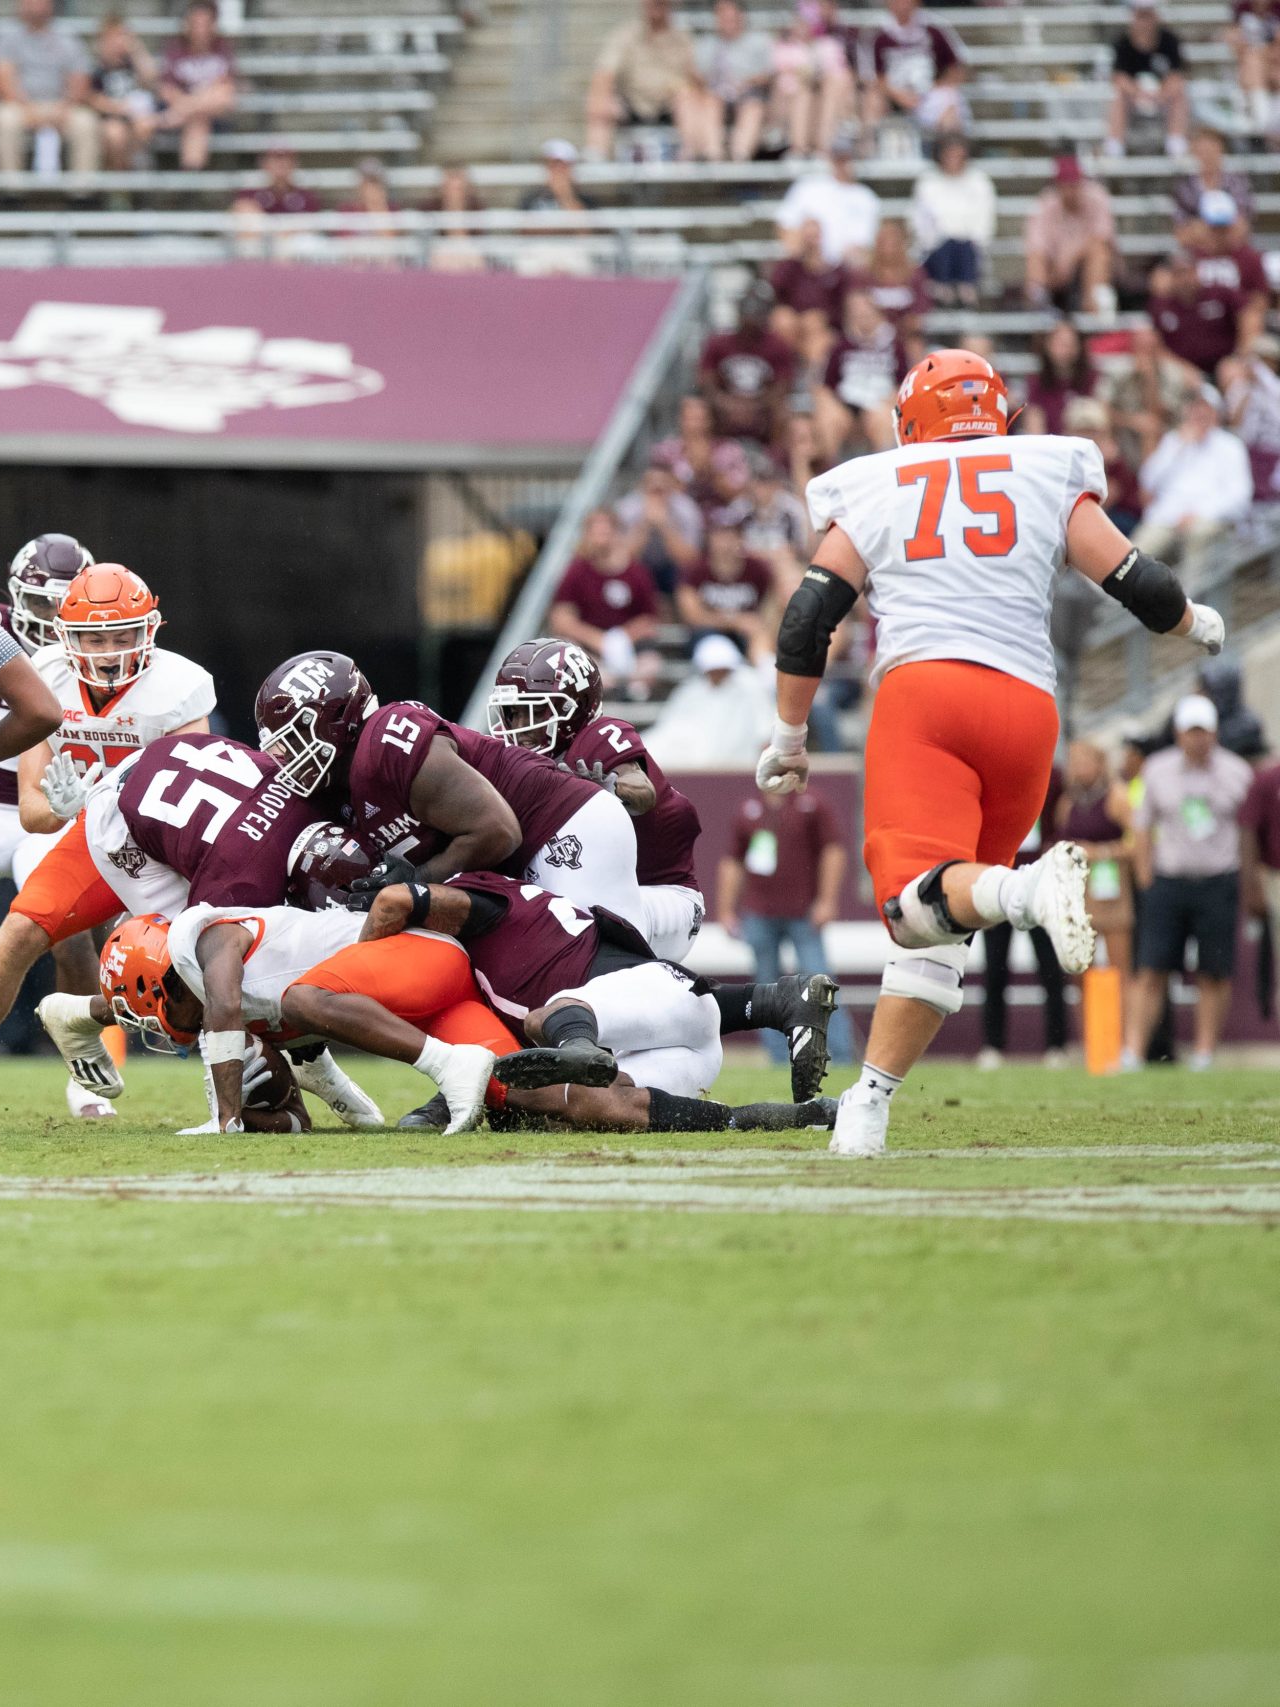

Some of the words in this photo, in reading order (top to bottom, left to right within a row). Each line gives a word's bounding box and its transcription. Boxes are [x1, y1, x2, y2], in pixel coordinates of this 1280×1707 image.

[951, 421, 998, 433] BEARKATS
[896, 454, 1018, 563] 75
[62, 709, 84, 723] AC
[55, 729, 80, 740] SAM
[83, 731, 140, 743] HOUSTON
[381, 713, 421, 755] 15
[598, 724, 632, 753] 2
[137, 740, 264, 845] 45
[378, 812, 421, 843] A&M
